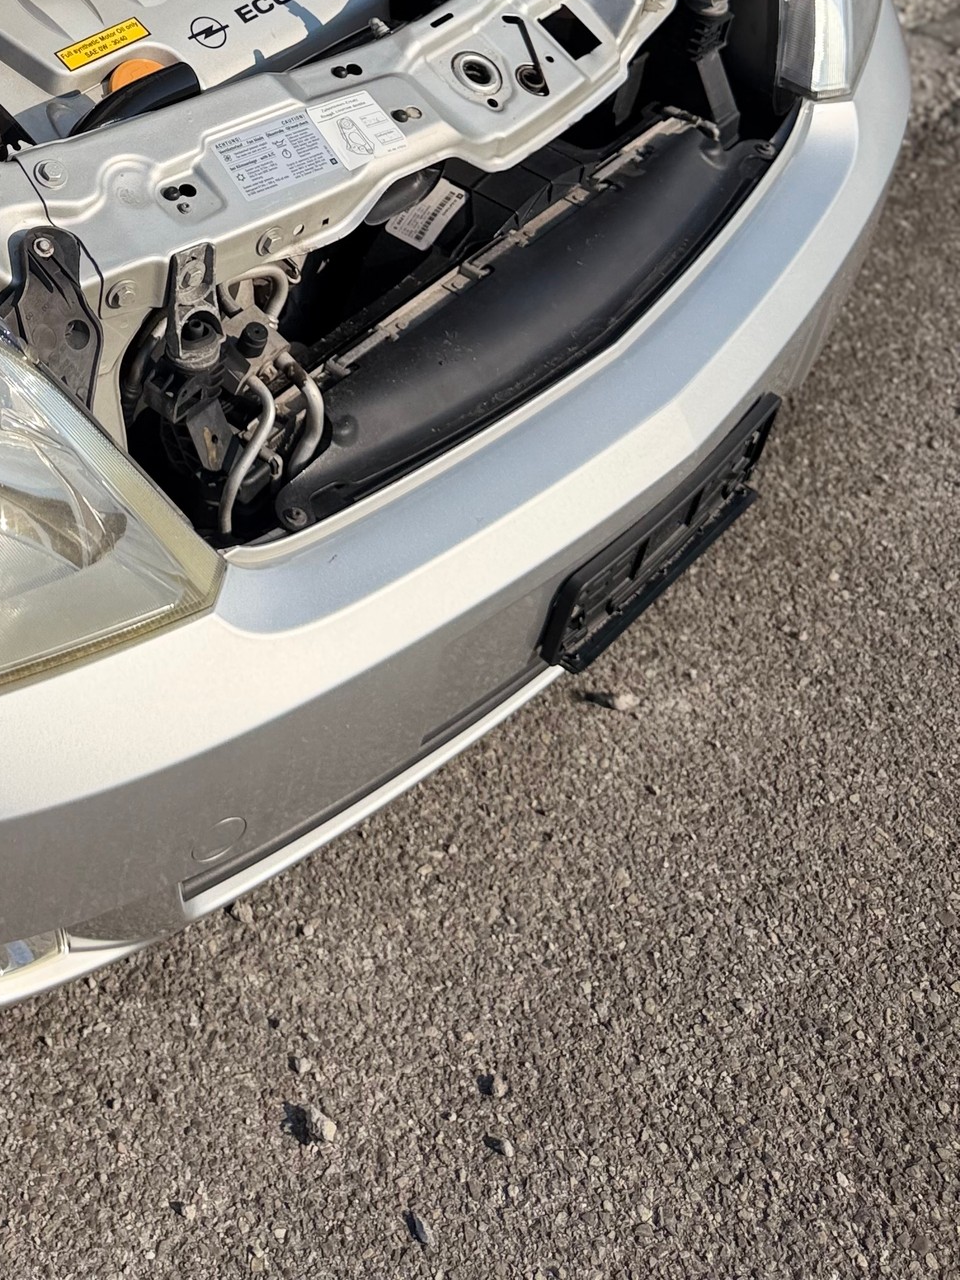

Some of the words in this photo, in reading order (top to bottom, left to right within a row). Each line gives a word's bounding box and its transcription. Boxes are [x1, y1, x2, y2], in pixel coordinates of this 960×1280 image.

[60, 51, 74, 60] Full
[73, 38, 100, 54] synthetic
[99, 31, 116, 42] Motor
[115, 26, 126, 35] Oil
[125, 21, 139, 30] only
[84, 49, 100, 58] SAE
